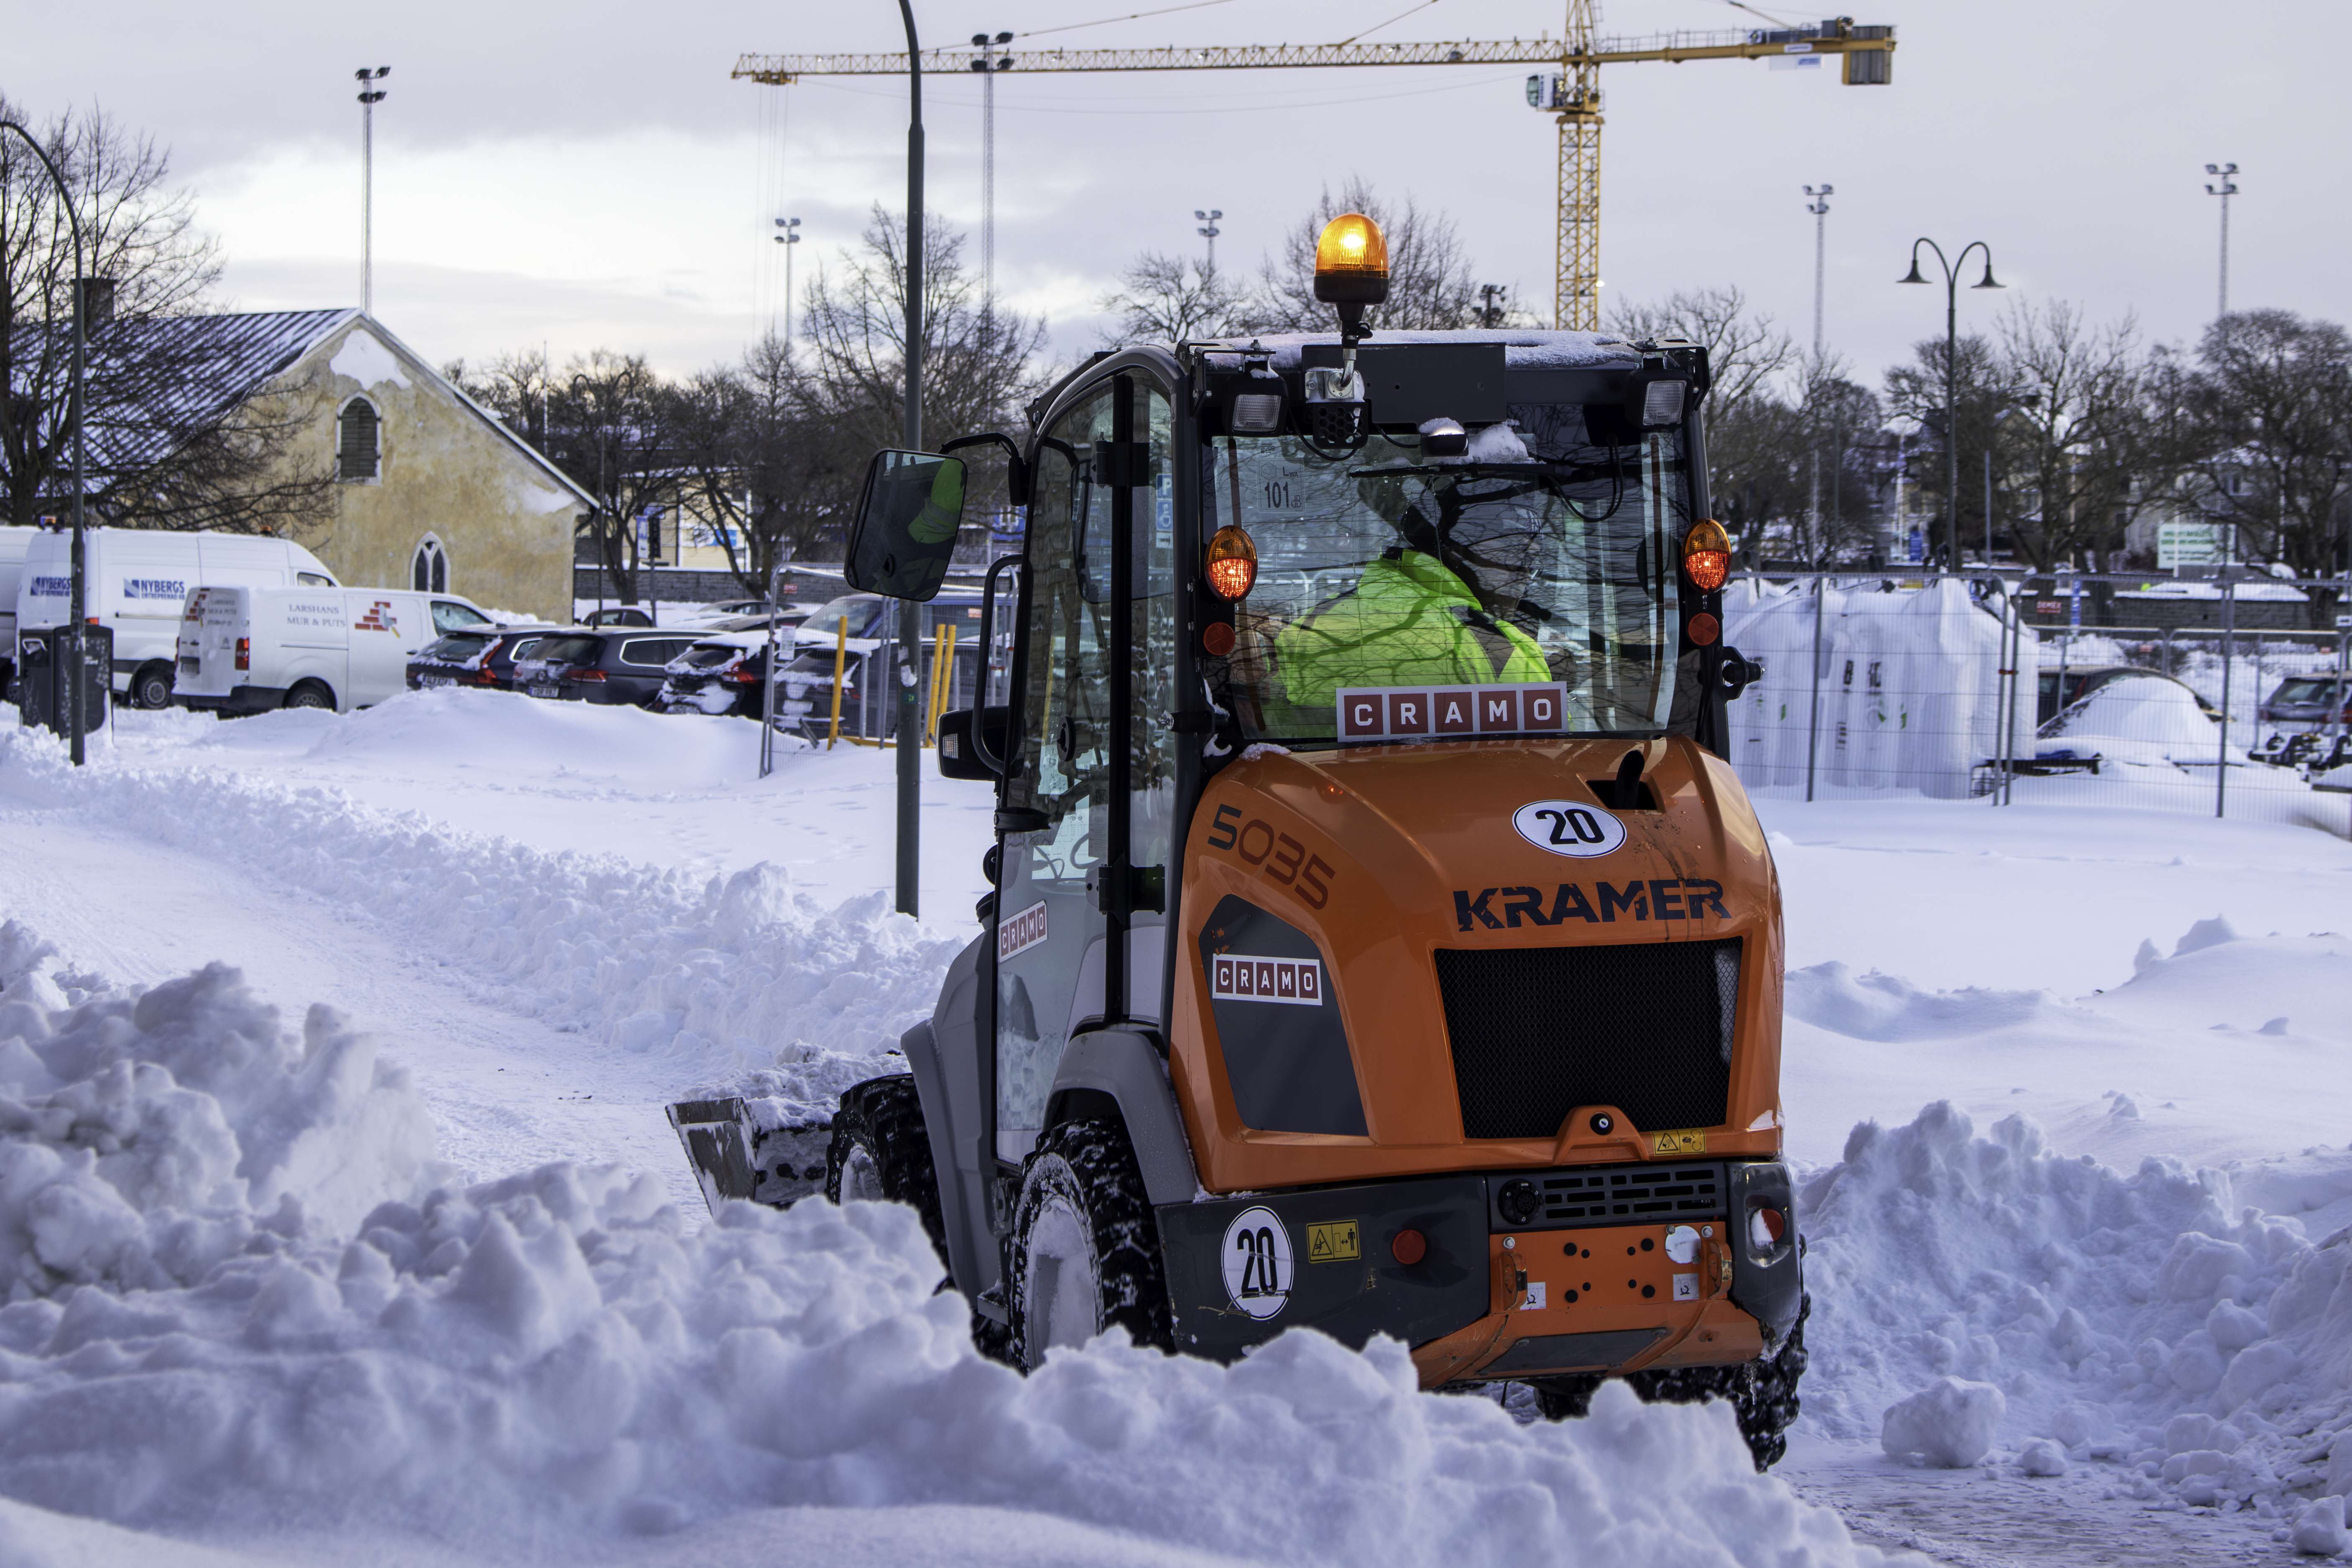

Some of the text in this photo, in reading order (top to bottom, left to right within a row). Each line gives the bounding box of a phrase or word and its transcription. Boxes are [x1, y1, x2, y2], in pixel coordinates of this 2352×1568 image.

[1162, 478, 1171, 495] P
[1264, 482, 1302, 508] 101 dB
[41, 577, 71, 590] NYBERGS
[141, 580, 184, 593] NYBERGS
[287, 616, 346, 628] MUR & PUTS
[289, 604, 339, 615] LARSHANS
[1354, 698, 1552, 726] CRAMO
[1535, 808, 1606, 845] 20
[1207, 803, 1336, 911] 5035
[1453, 878, 1732, 932] KRAMER
[1002, 913, 1044, 950] CRAMO
[1220, 967, 1313, 991] CRAMO
[1237, 1226, 1278, 1299] 20
